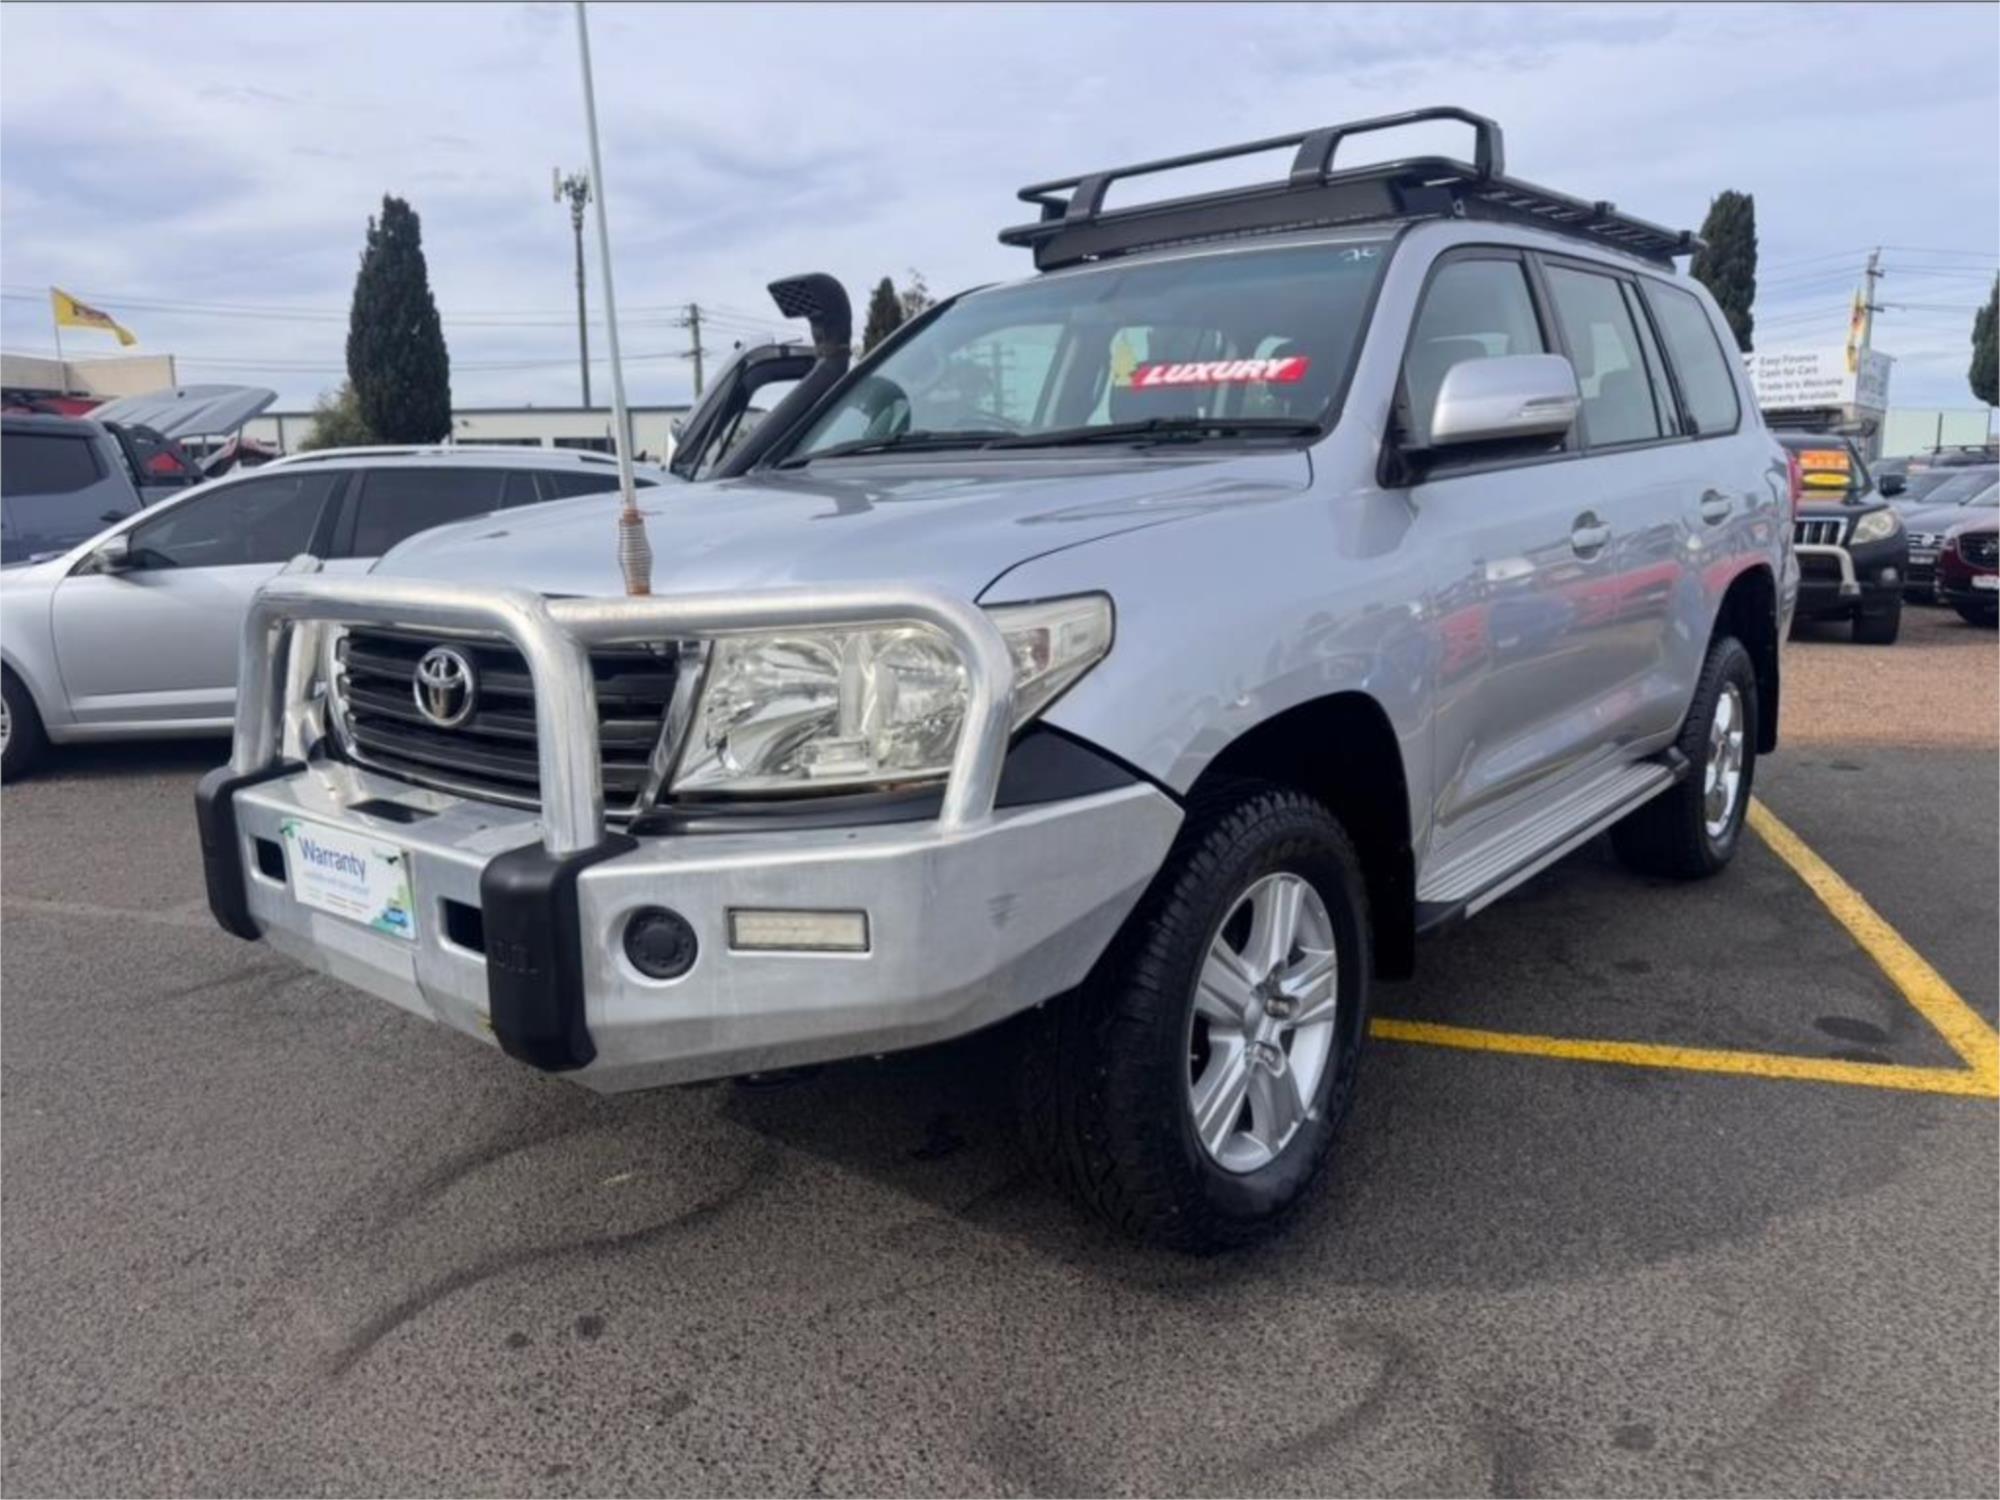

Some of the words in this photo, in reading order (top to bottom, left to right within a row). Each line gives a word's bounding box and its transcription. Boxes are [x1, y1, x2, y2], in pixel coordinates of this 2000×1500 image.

[1759, 355, 1782, 367] Easy
[1782, 354, 1818, 364] Finance
[1142, 357, 1296, 386] LUXURY
[1759, 367, 1782, 378] Cash
[1797, 364, 1819, 375] Cars
[1802, 378, 1844, 389] Welcome
[298, 836, 366, 883] Warranty
